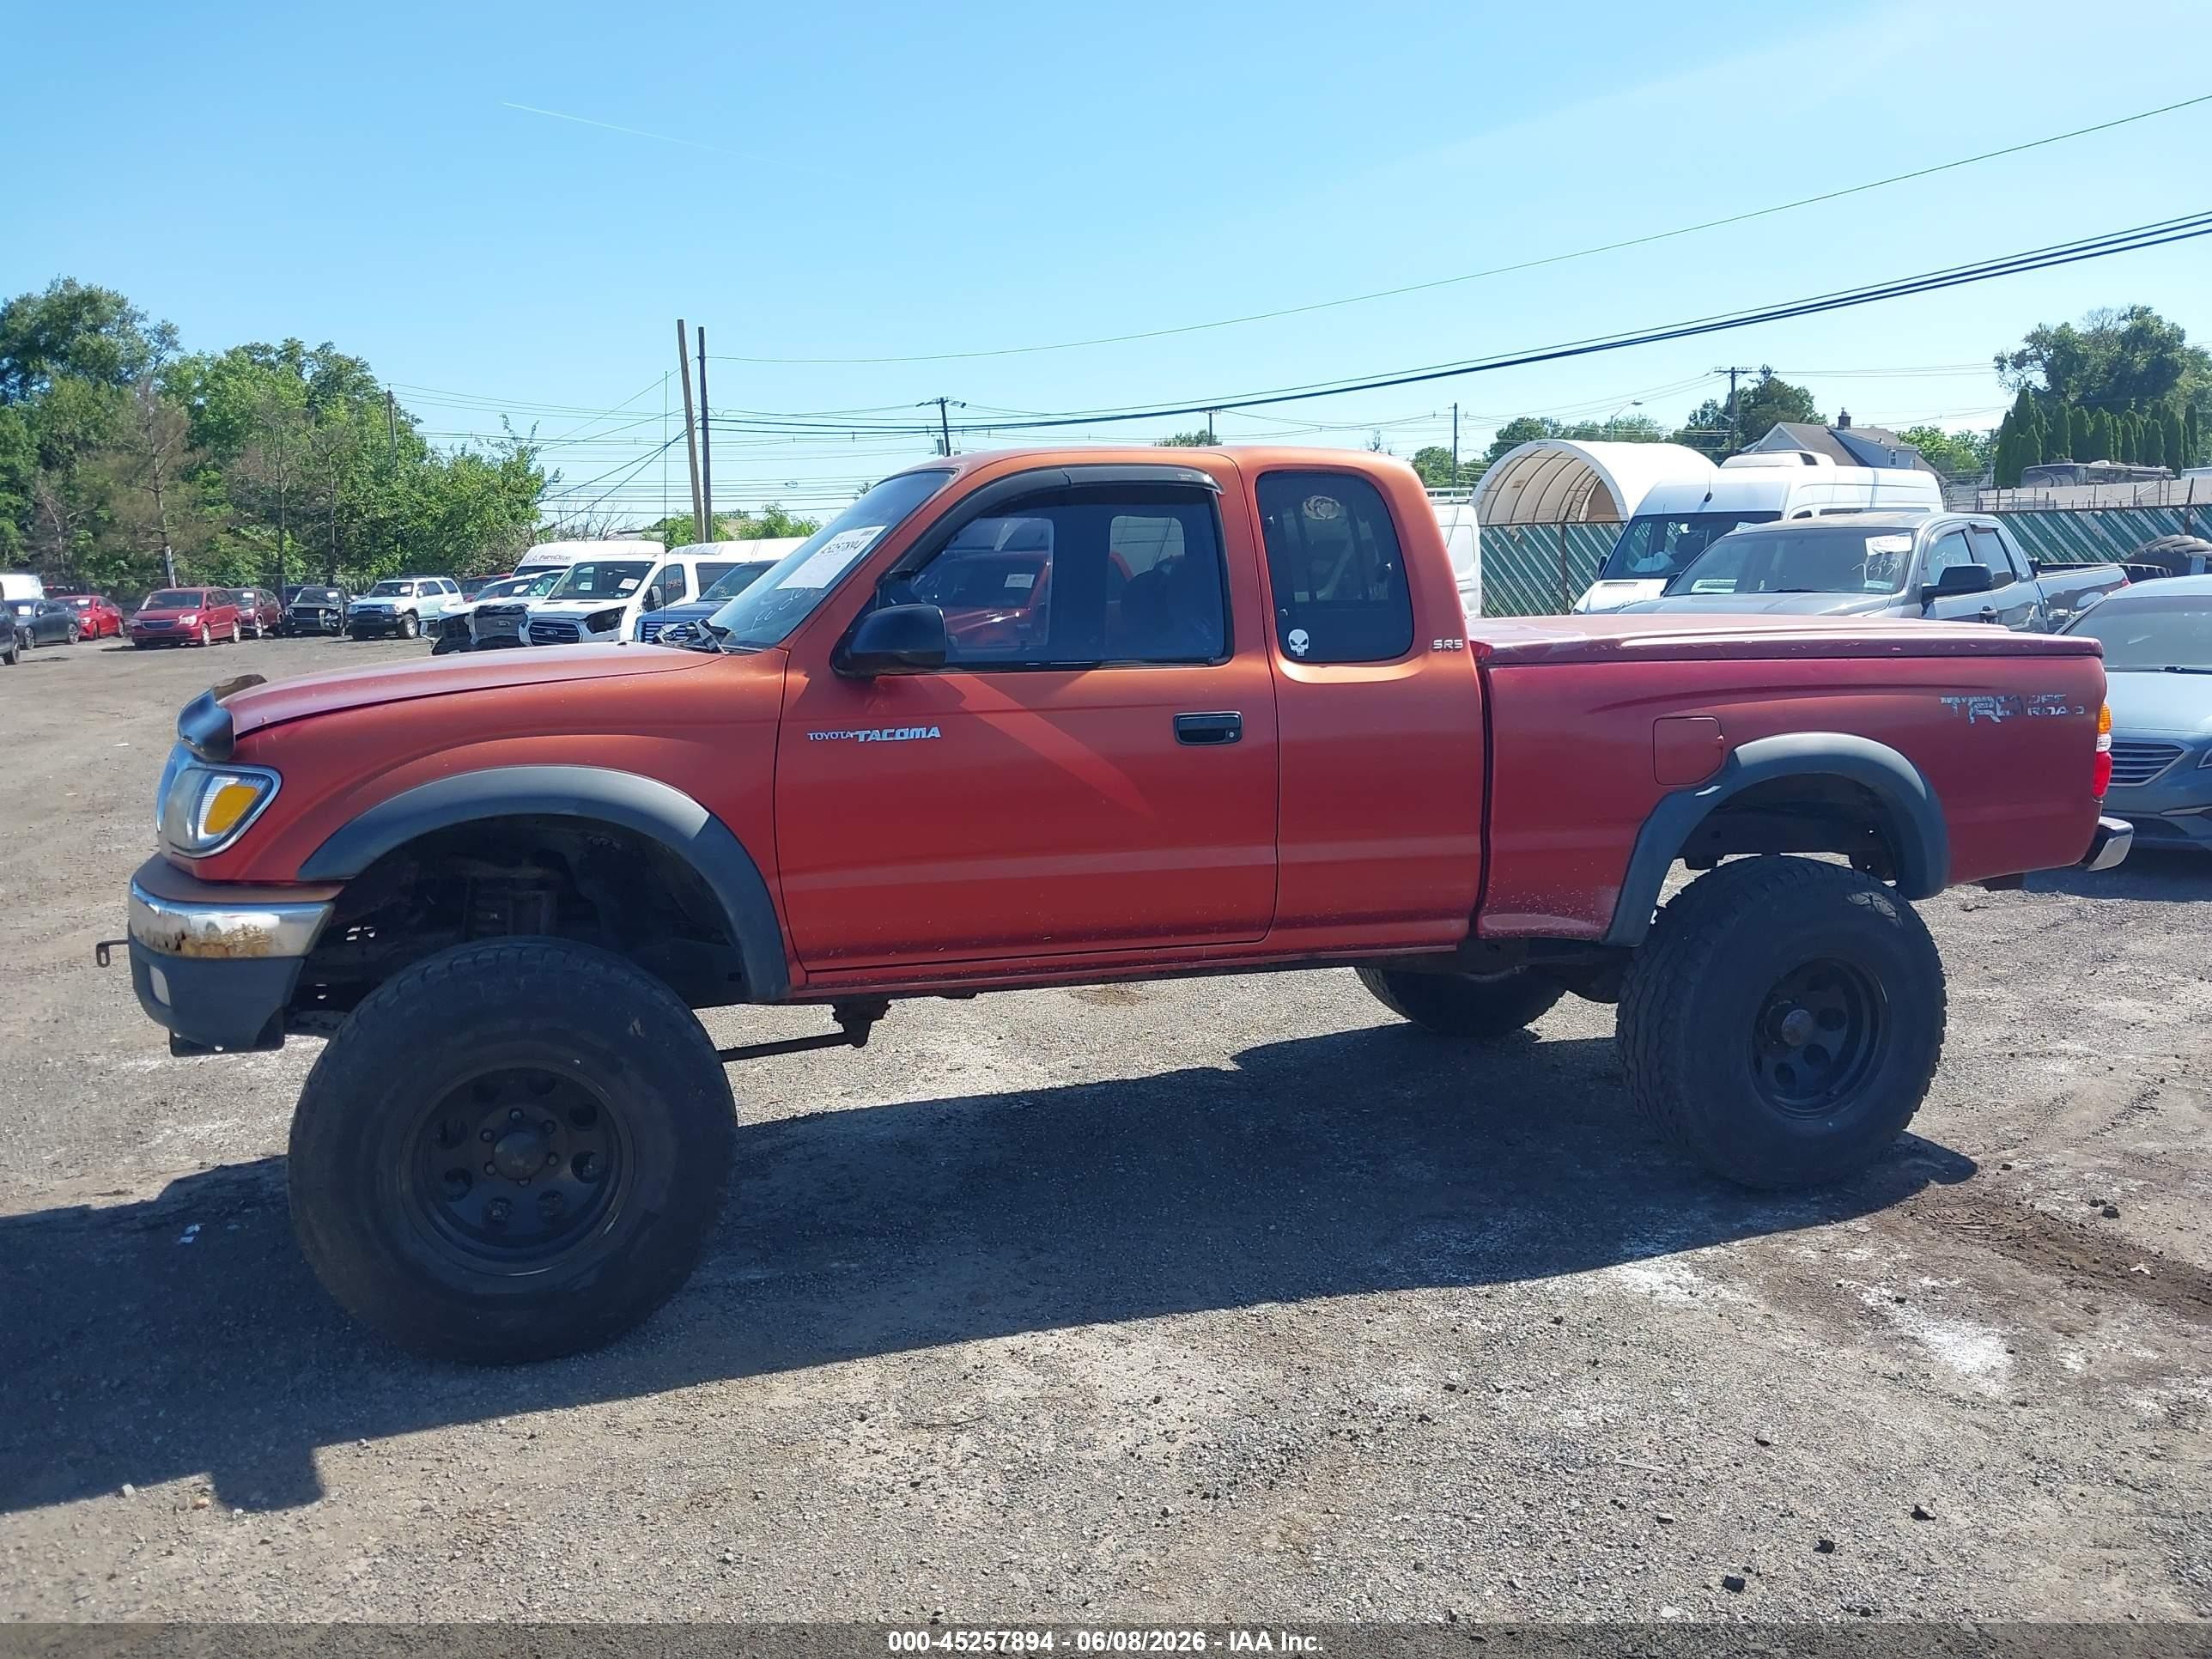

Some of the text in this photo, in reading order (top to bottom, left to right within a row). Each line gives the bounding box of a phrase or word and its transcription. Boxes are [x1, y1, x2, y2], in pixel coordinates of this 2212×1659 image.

[1432, 639, 1464, 649] SR5
[807, 726, 942, 743] TOYOTA TACOMA
